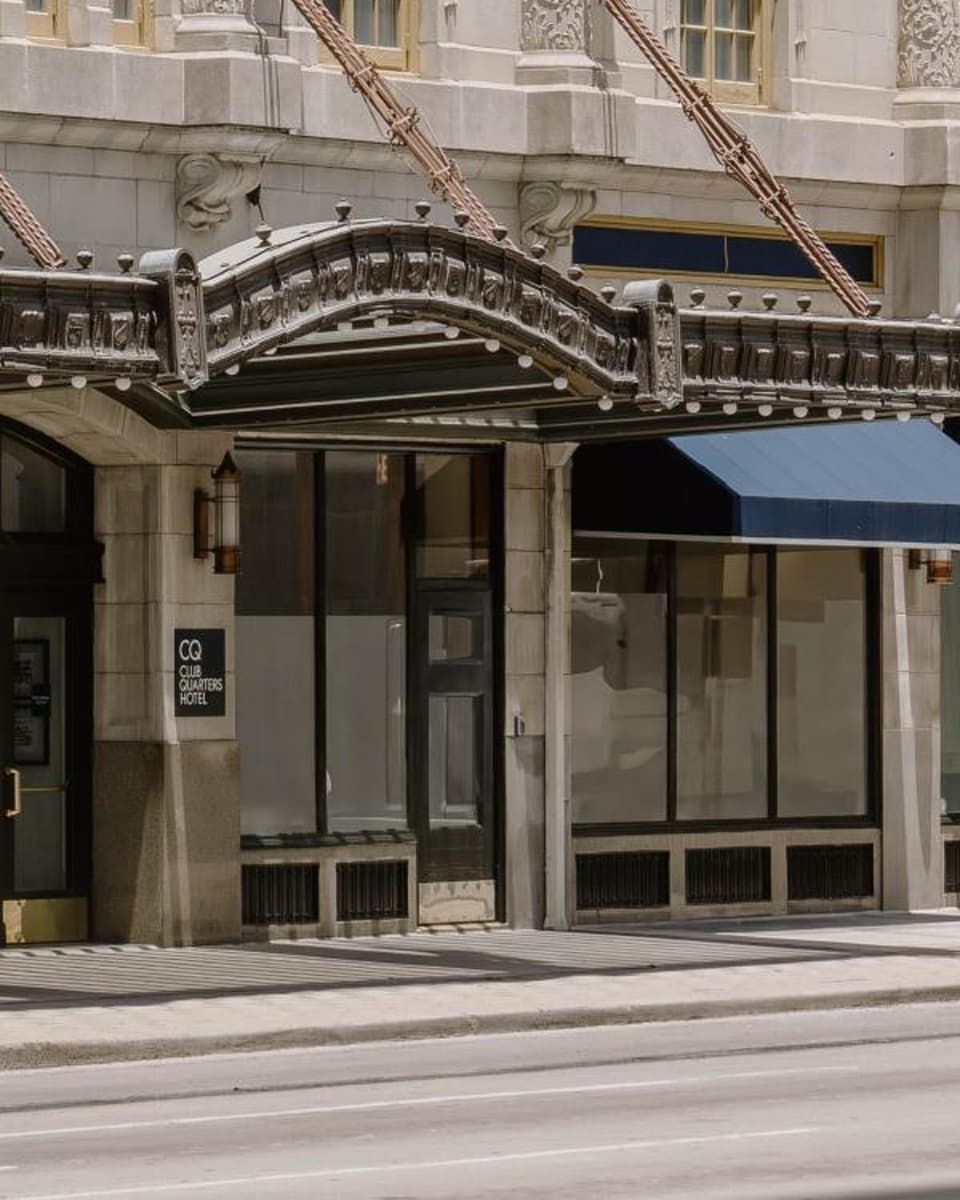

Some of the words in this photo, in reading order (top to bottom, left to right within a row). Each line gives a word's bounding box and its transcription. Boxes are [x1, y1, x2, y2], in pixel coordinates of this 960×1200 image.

[179, 639, 202, 661] CQ
[179, 664, 202, 678] CLUB
[179, 678, 223, 692] QUARTERS
[180, 692, 208, 705] HOTEL
